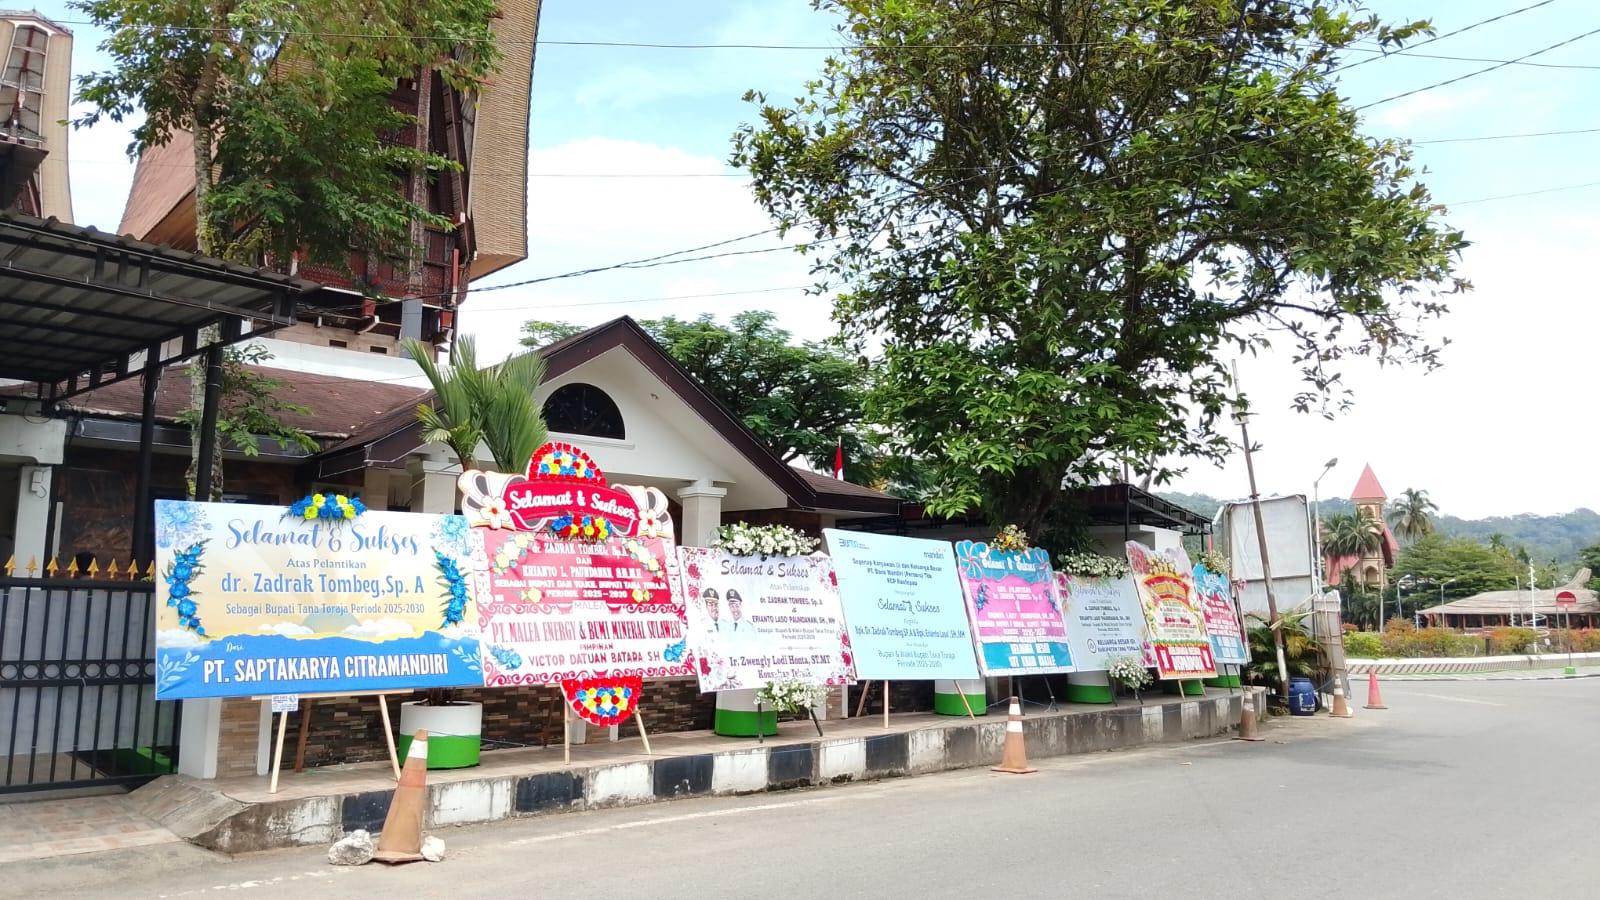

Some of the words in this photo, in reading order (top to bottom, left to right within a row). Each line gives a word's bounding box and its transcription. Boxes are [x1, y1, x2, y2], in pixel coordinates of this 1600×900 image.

[509, 490, 573, 511] Selamat
[577, 490, 586, 506] &
[591, 493, 637, 520] Sukses
[226, 518, 322, 551] Selamat
[328, 527, 342, 552] &
[350, 523, 420, 555] Sukses
[286, 558, 310, 568] Atas
[313, 558, 367, 569] Pelantikan
[720, 560, 763, 576] Selamat
[767, 565, 774, 575] &
[777, 563, 809, 578] Sukses
[221, 573, 247, 592] dr.
[254, 573, 314, 593] Zadrak
[415, 575, 425, 593] A
[226, 603, 262, 616] Sebagai
[265, 603, 295, 616] Bupati
[298, 604, 319, 614] Tana
[322, 603, 348, 616] Toraja
[351, 603, 381, 614] Periode
[384, 603, 425, 614] 2025-2030
[574, 602, 607, 610] MALEA
[877, 598, 908, 611] Selamat
[915, 600, 941, 613] Sukses
[509, 622, 540, 642] MALEA
[542, 621, 577, 641] ENERGY
[579, 621, 586, 640] &
[587, 621, 610, 640] BUMI
[611, 620, 646, 640] MINERAL
[528, 654, 565, 666] VICTOR
[569, 653, 606, 665] DATUAN
[740, 655, 771, 669] Zwengly
[772, 655, 788, 665] Lodi
[204, 659, 230, 684] PT.
[235, 655, 341, 682] SAPTAKARYA
[344, 653, 449, 679] CITRAMANDIRI
